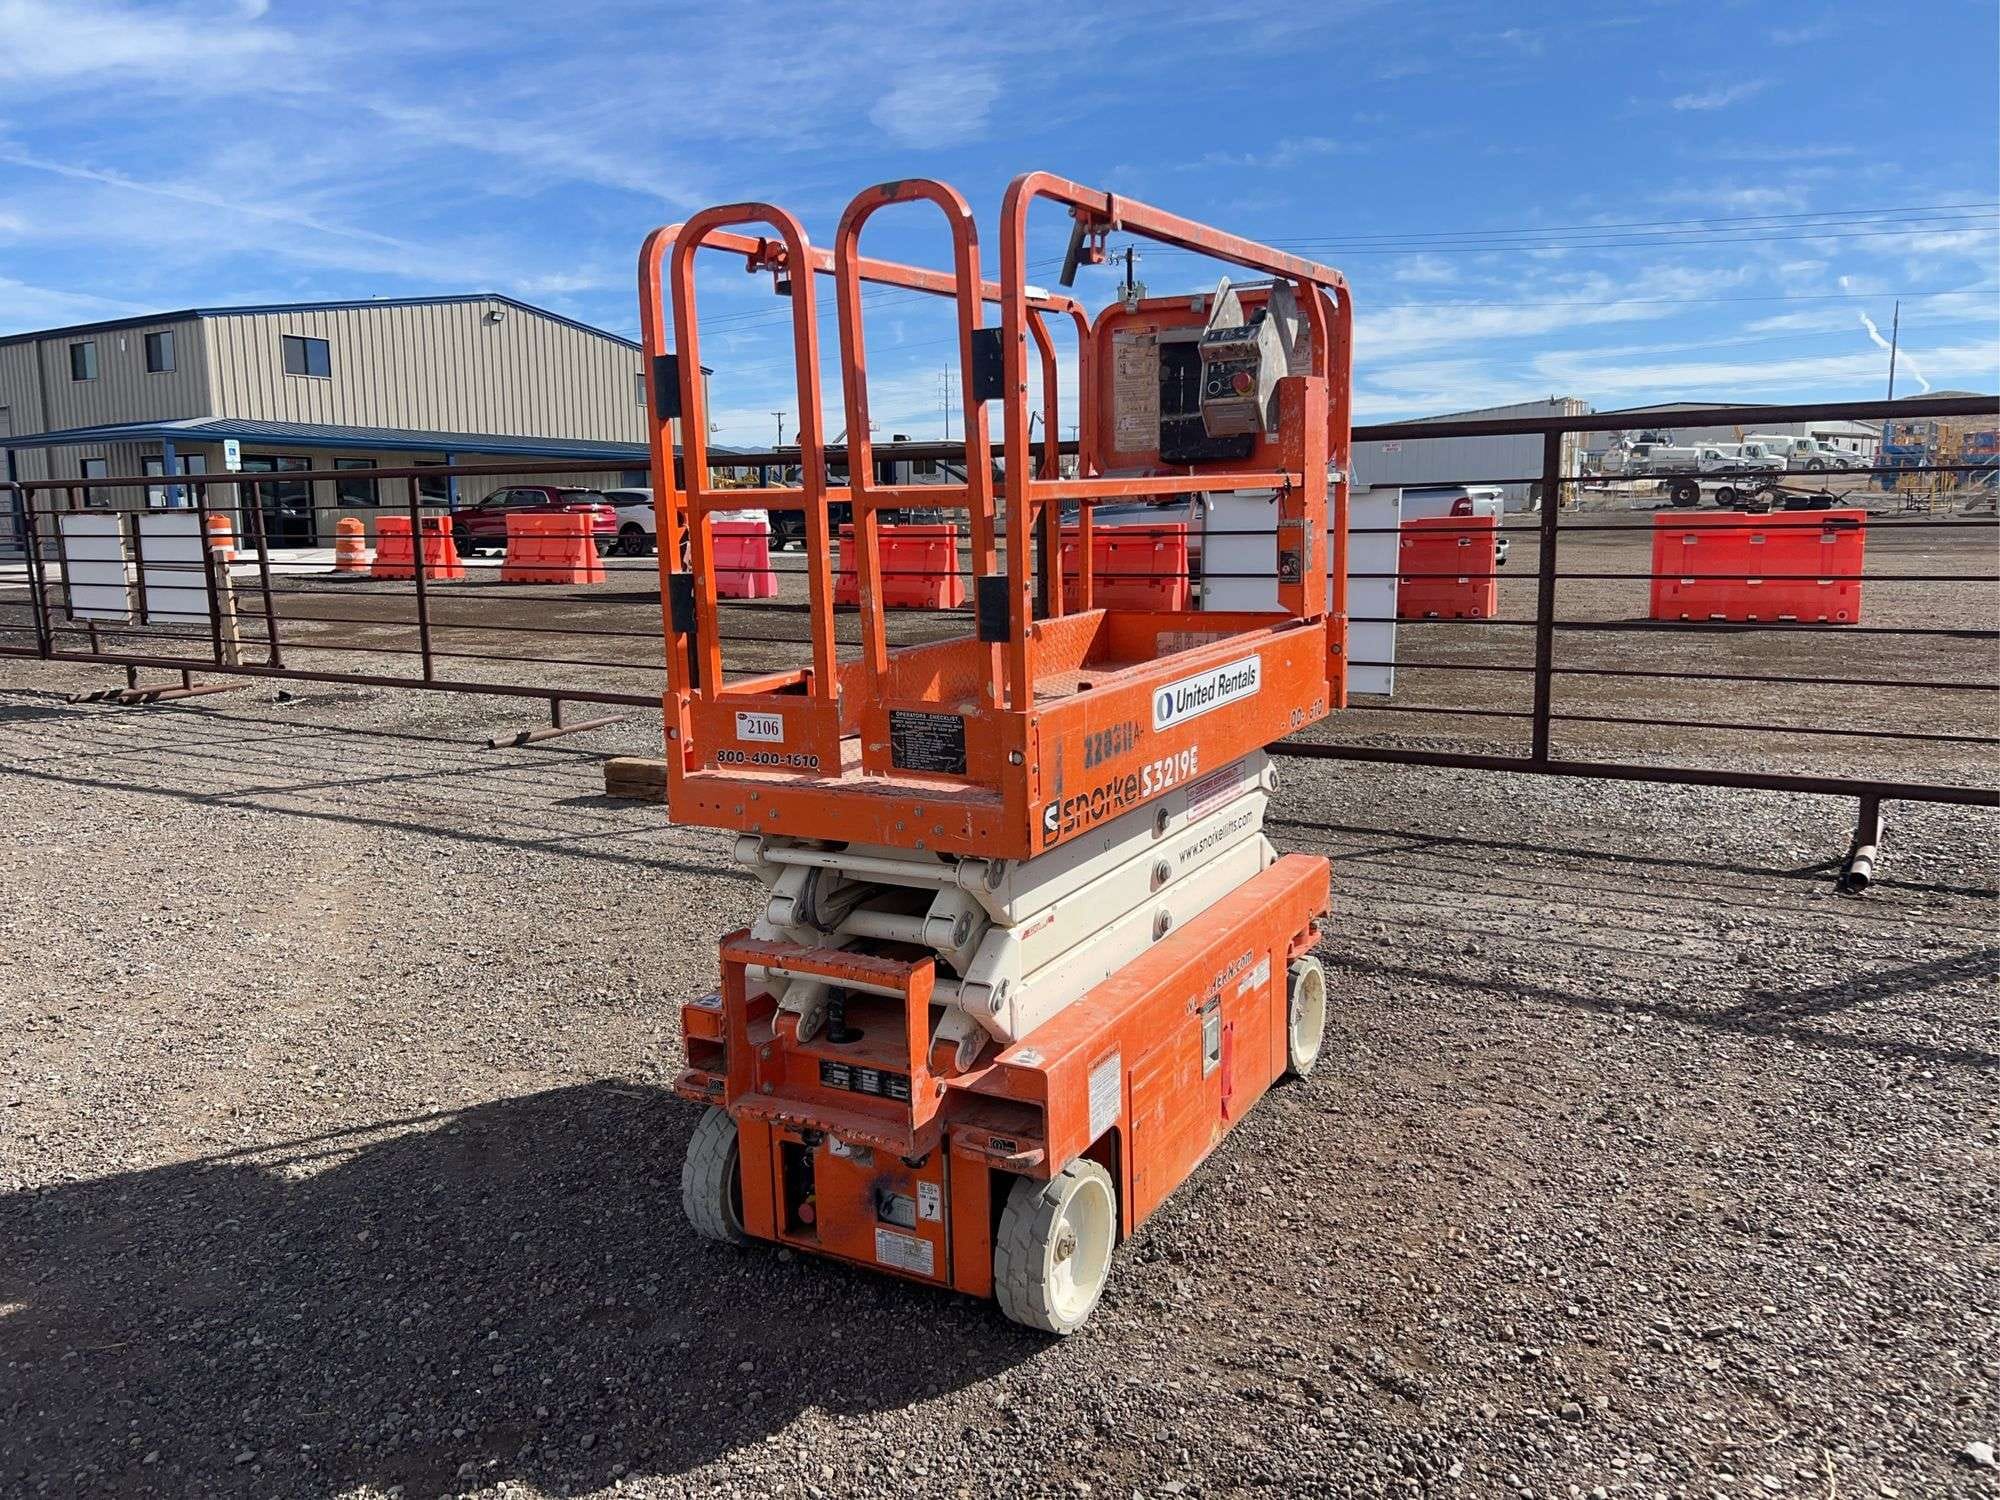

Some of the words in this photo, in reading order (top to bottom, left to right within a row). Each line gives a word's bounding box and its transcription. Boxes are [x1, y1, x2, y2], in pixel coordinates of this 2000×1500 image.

[1176, 677, 1216, 714] United
[1217, 664, 1256, 698] Rentals
[747, 719, 779, 736] 2106
[716, 750, 819, 768] 800-400-1610
[1063, 766, 1143, 835] snorkel
[1142, 745, 1199, 798] S3219E
